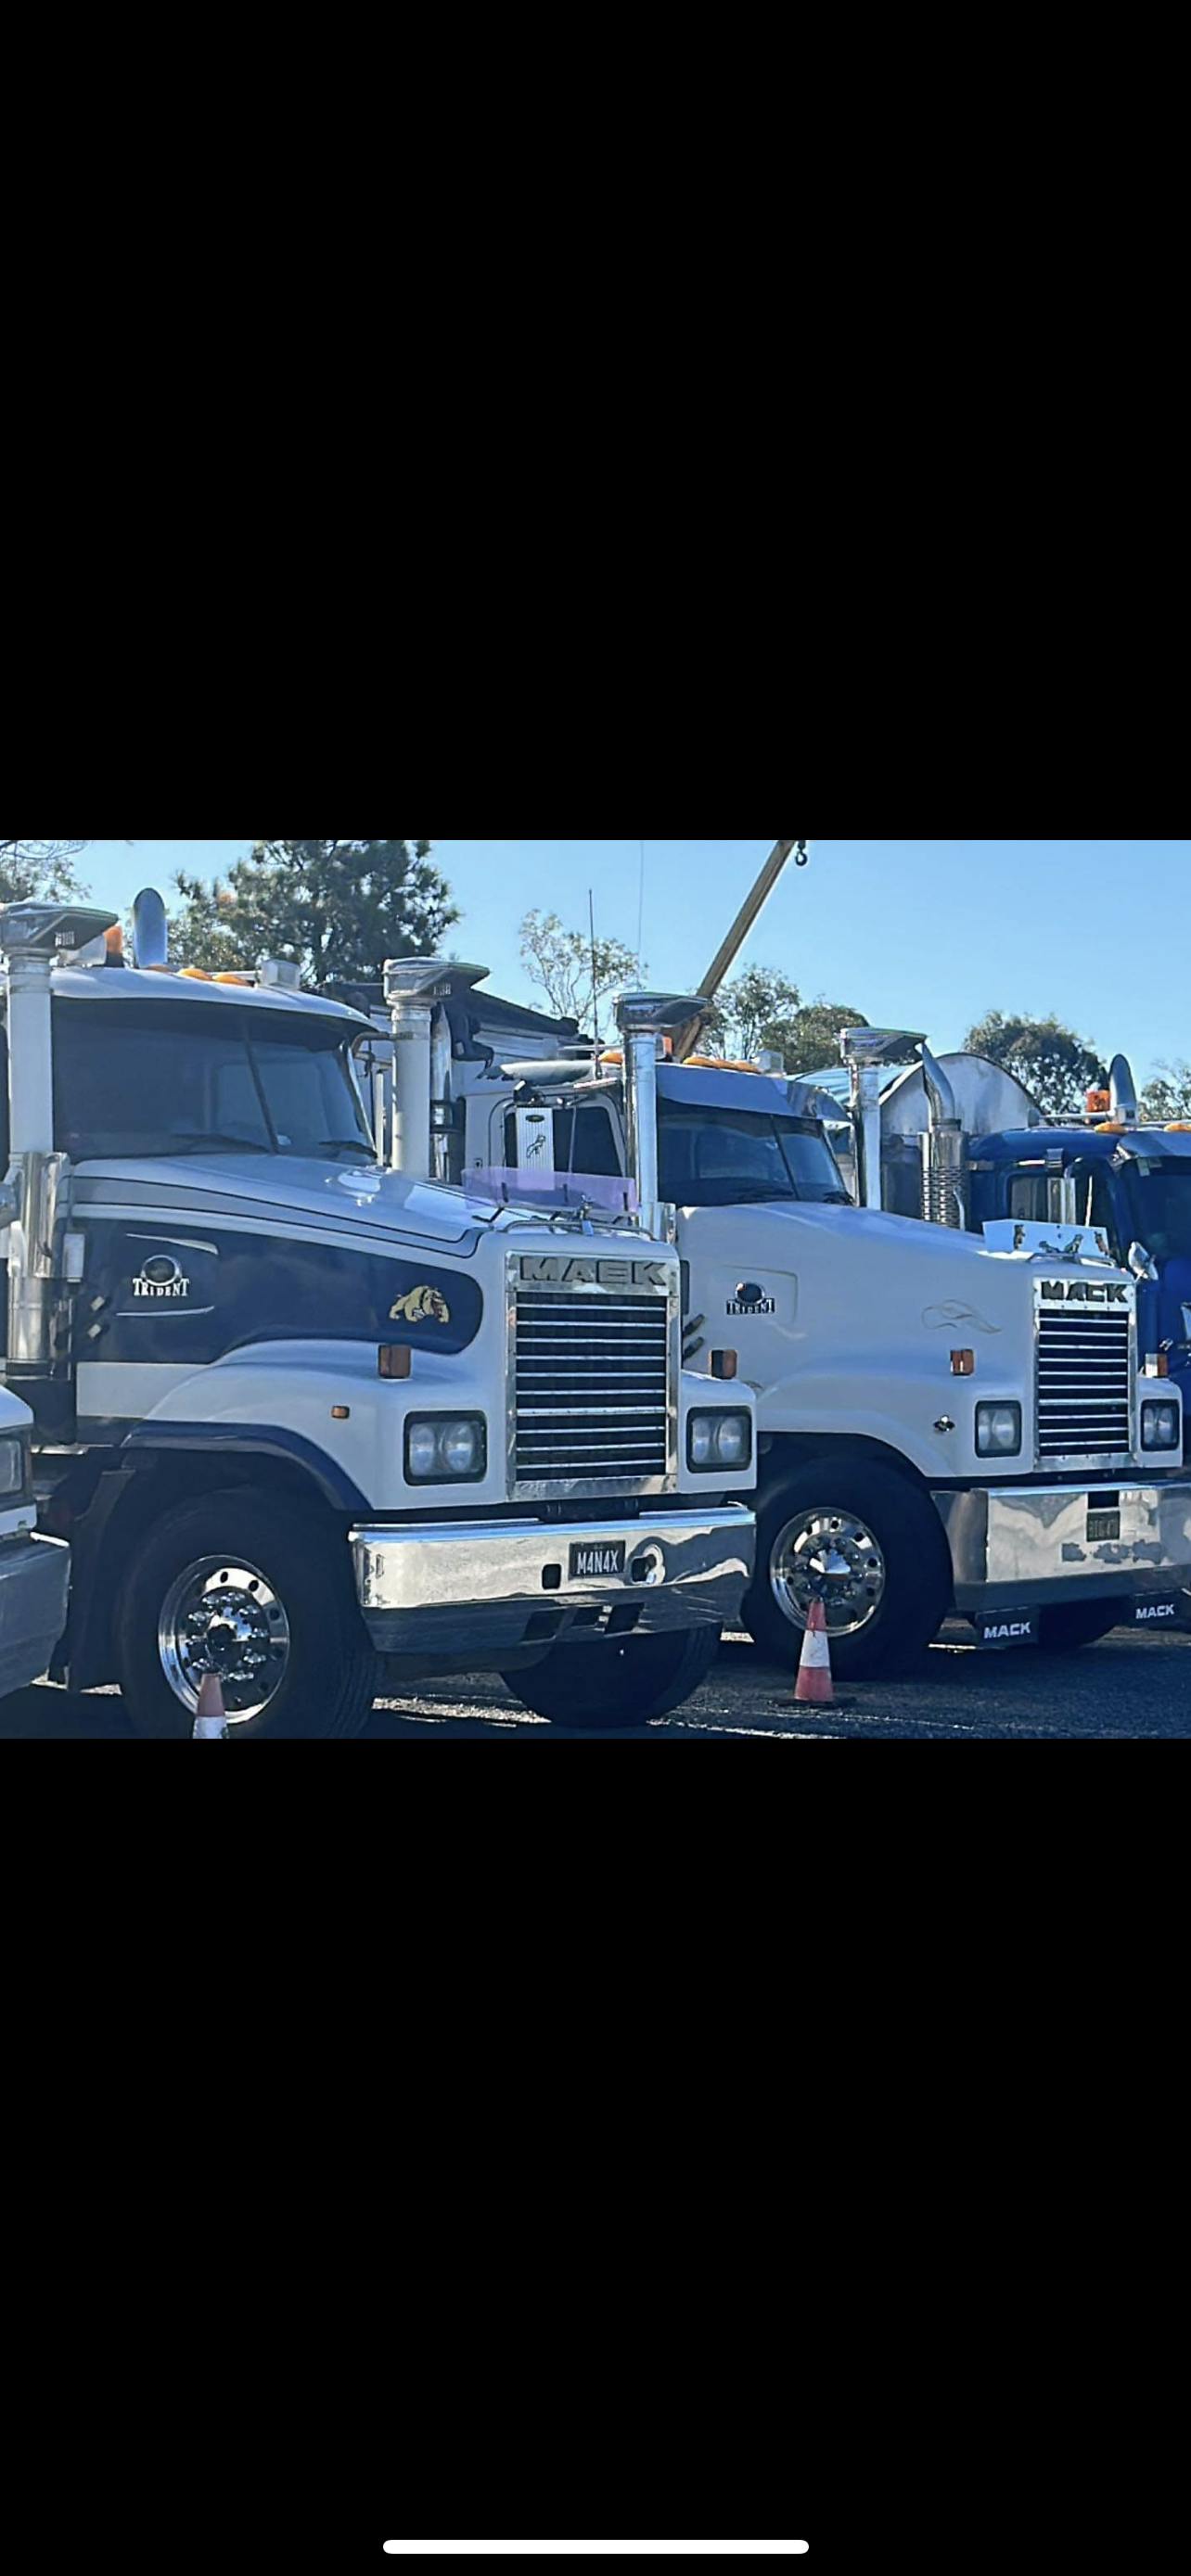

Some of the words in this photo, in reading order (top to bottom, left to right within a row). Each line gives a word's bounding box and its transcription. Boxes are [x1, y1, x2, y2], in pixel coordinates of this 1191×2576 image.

[133, 1278, 190, 1296] TRIDENT
[1041, 1281, 1128, 1303] MACK
[577, 1549, 619, 1575] M4N4X
[1135, 1604, 1174, 1619] MACK
[984, 1622, 1031, 1639] MACK
